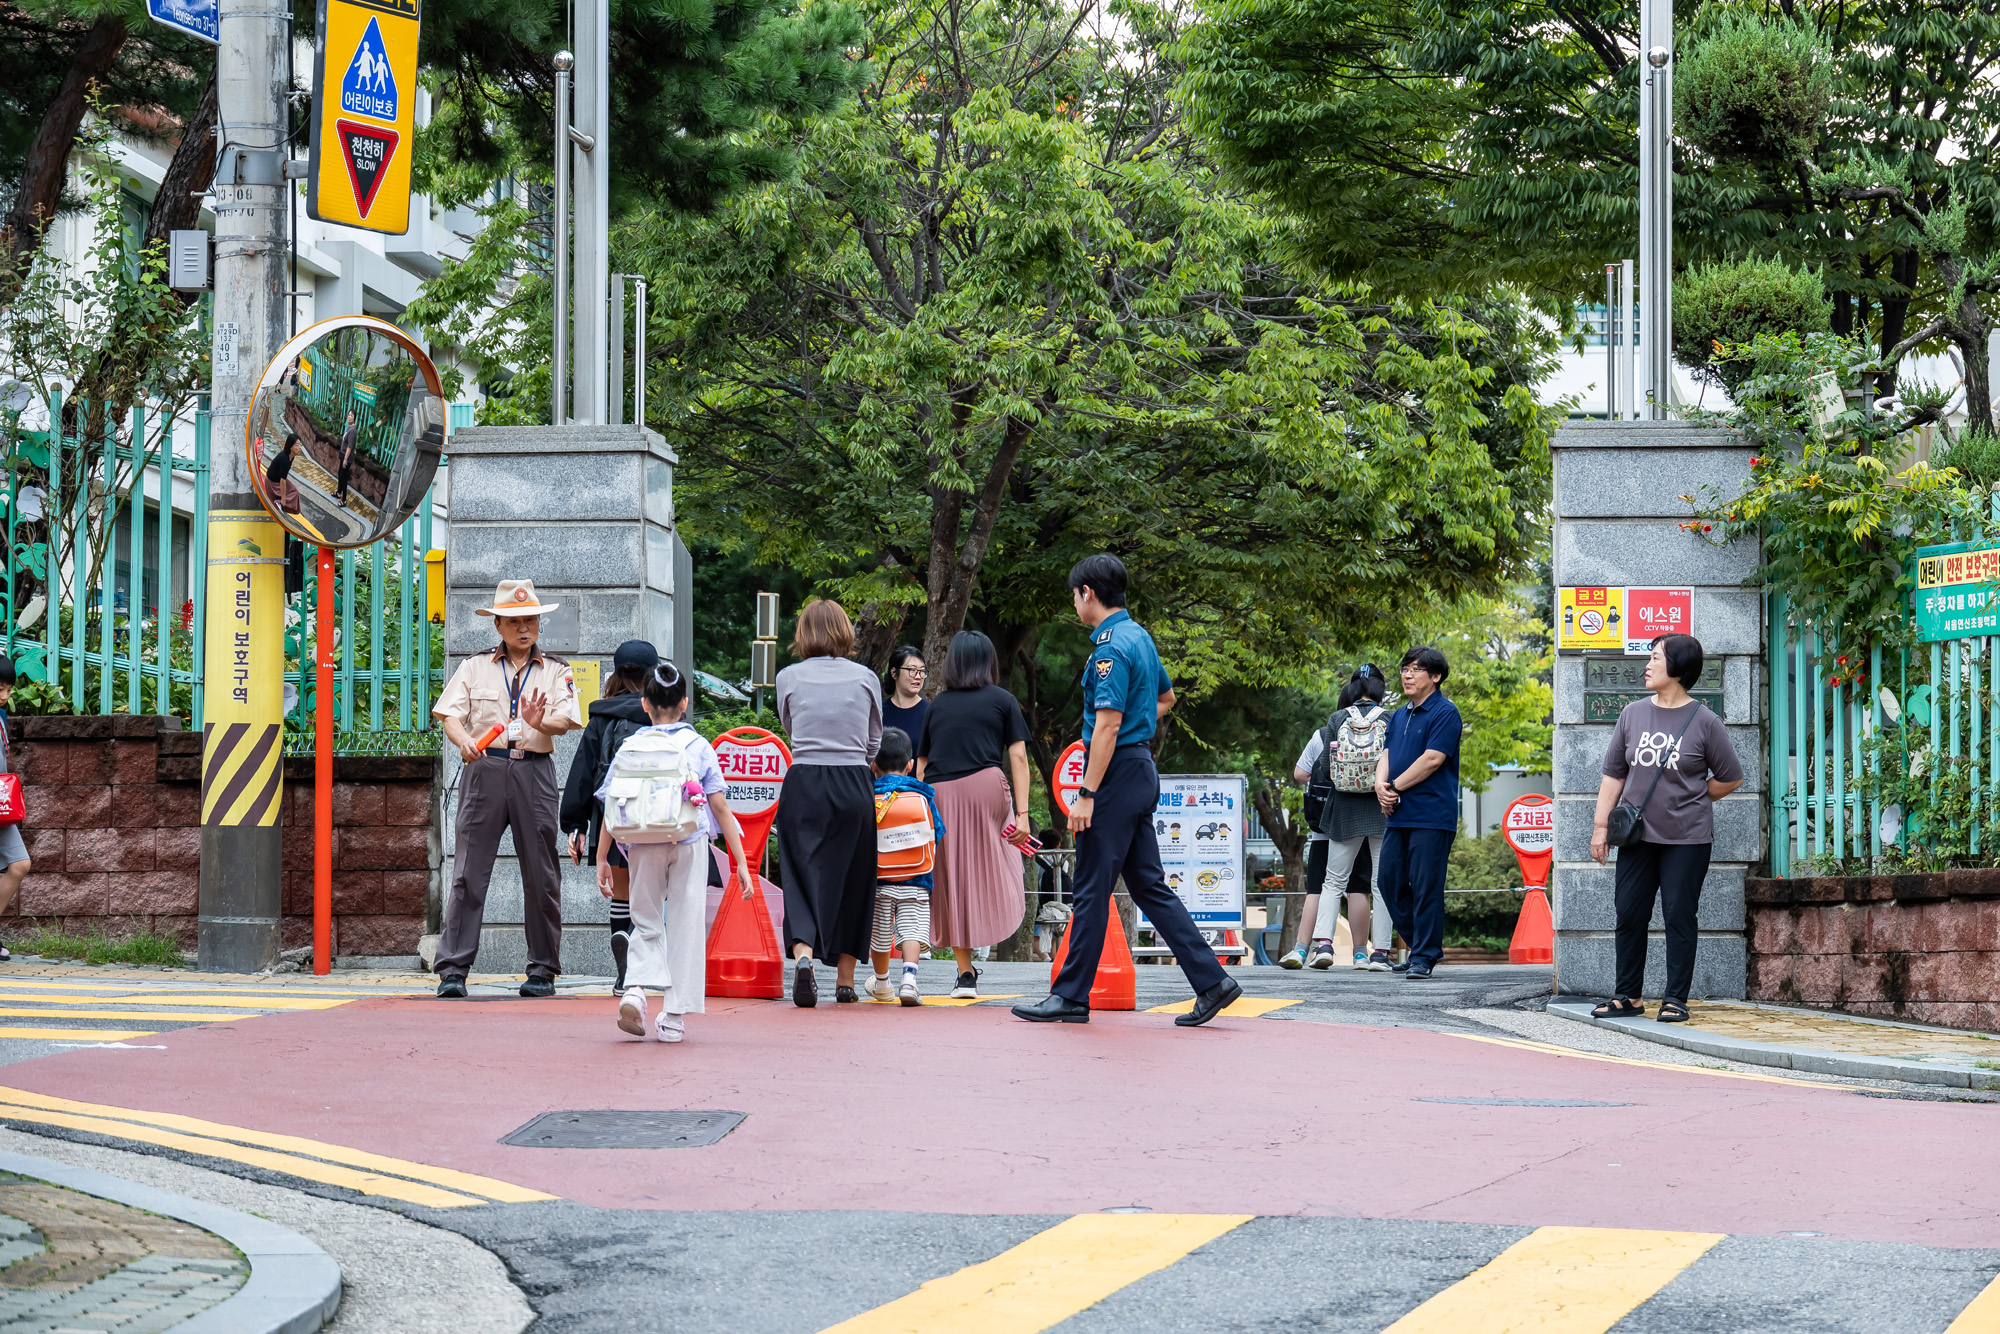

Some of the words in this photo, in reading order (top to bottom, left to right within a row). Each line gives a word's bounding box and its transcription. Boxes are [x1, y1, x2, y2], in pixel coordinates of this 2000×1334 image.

[345, 91, 394, 117] 어린이보호
[351, 136, 384, 162] 천천히
[356, 158, 376, 172] SLOW
[219, 352, 230, 361] L3
[1919, 559, 1944, 585] 어린이
[1946, 556, 1963, 582] 안전
[1965, 551, 2000, 579] 보호구역
[234, 571, 251, 626] 어린이
[1967, 592, 1985, 608] 하지
[1639, 606, 1682, 623] 에스원
[1943, 615, 1997, 631] 서울연신초등학교
[232, 631, 250, 705] 보호구역
[717, 753, 780, 775] 주차금지
[725, 785, 775, 801] 울연신초등학교
[1159, 792, 1183, 807] 예방
[1199, 792, 1223, 807] 수칙
